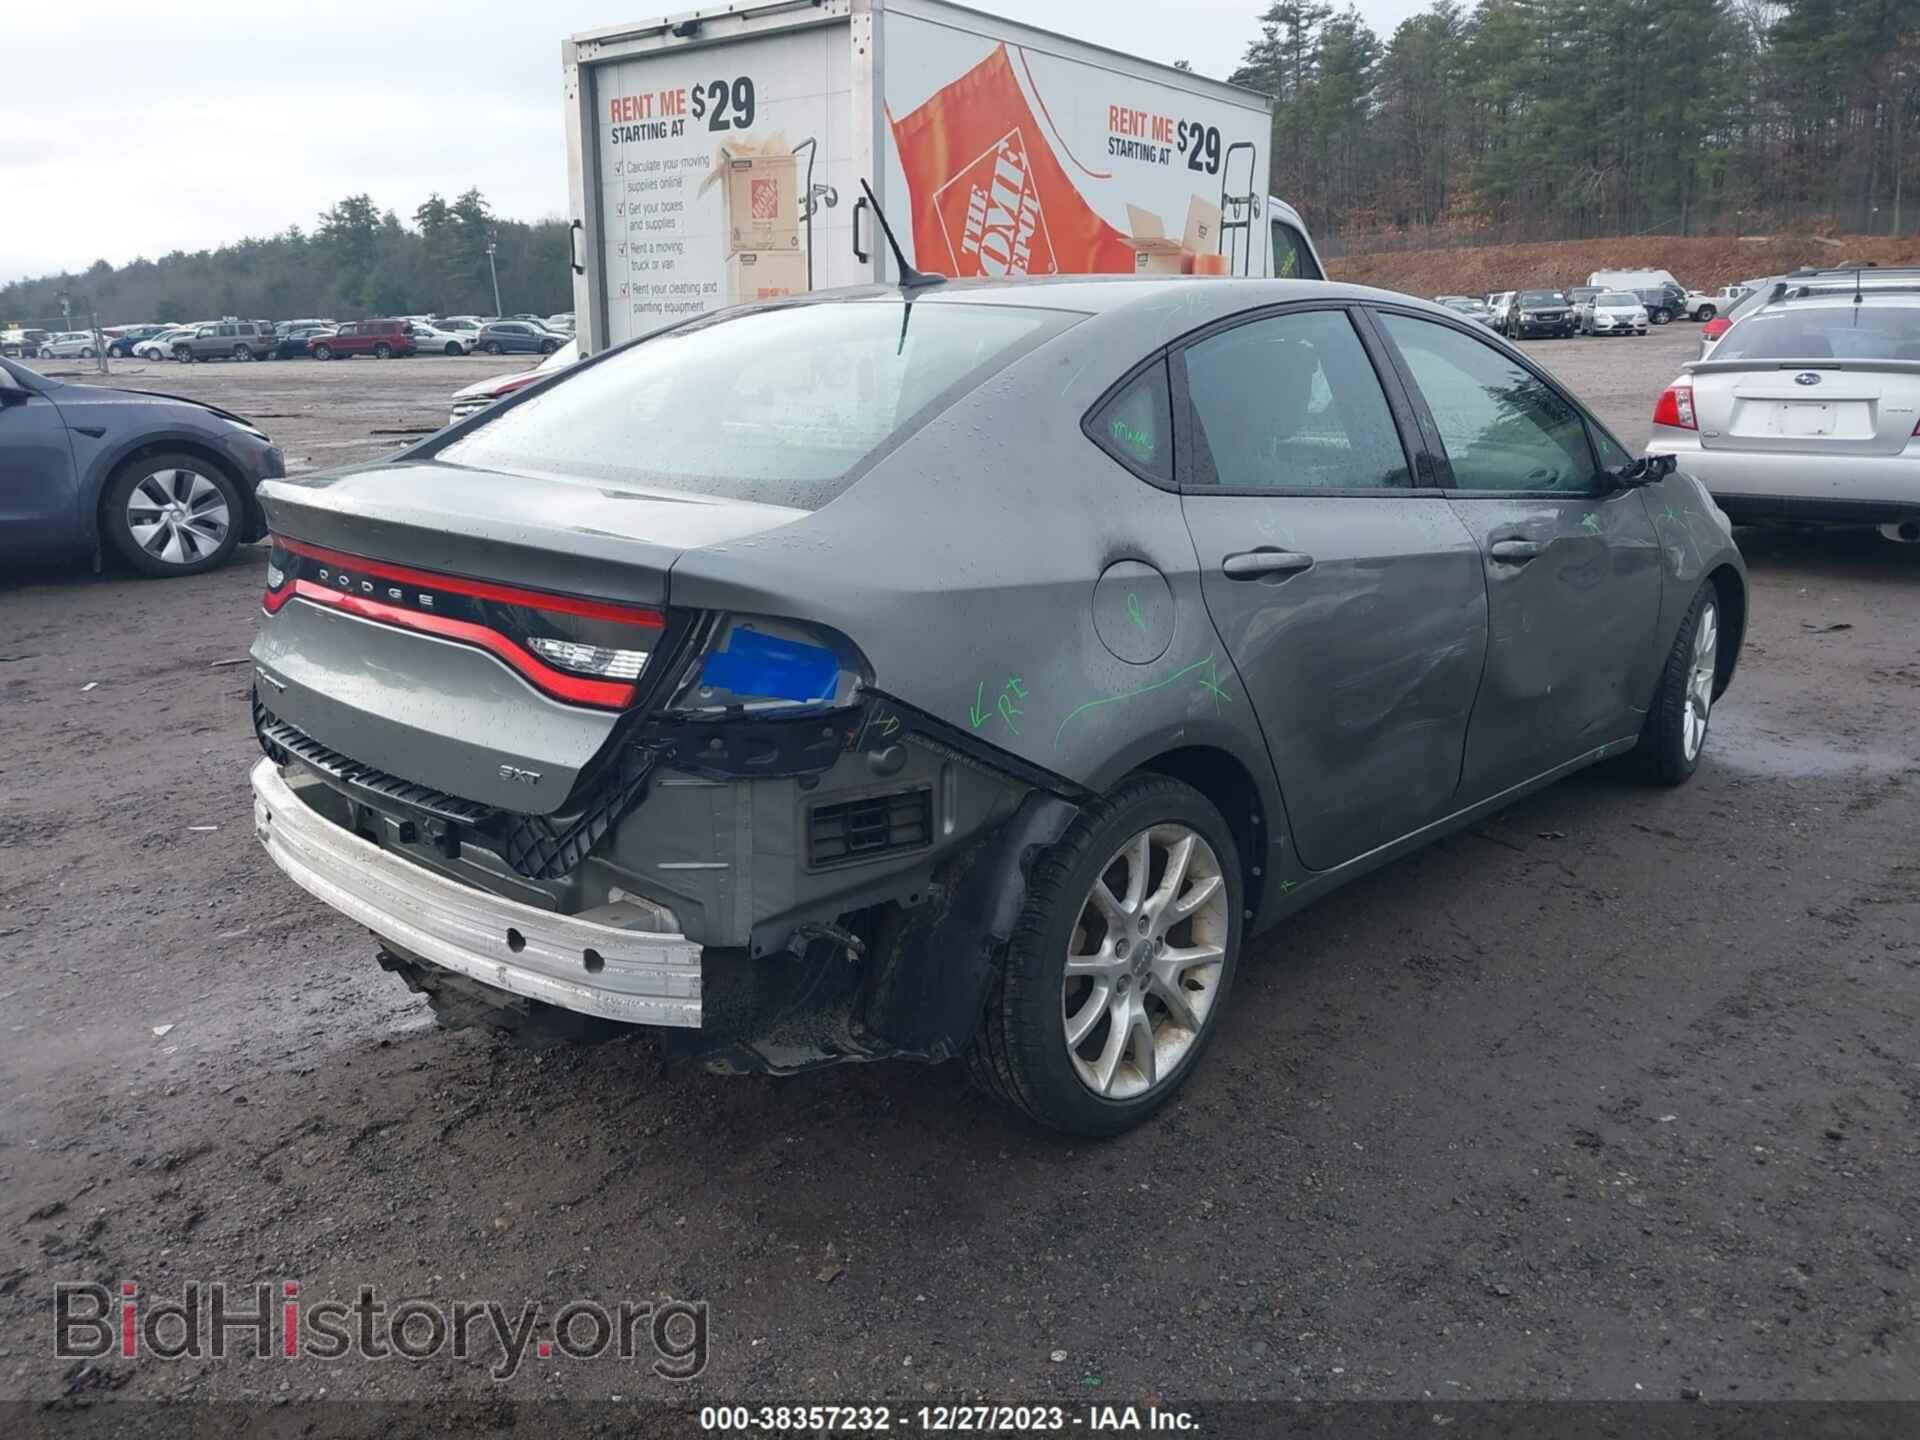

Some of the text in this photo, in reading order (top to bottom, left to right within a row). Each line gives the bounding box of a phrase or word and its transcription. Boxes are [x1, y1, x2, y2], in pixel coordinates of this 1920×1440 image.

[610, 75, 756, 132] RENT ME $29
[611, 119, 685, 145] STARTING AT
[1109, 105, 1221, 176] RENT ME $29
[1108, 136, 1171, 166] STARTING AT
[626, 154, 710, 174] Calculate your moving
[627, 176, 683, 193] supplies online
[628, 201, 684, 217] Get your boxes
[976, 138, 1027, 279] OME
[629, 218, 676, 232] and supplies
[961, 183, 989, 255] THE
[631, 242, 648, 255] Rent
[656, 241, 684, 256] moving
[631, 260, 675, 272] truck or van
[633, 281, 718, 297] Rent your cleaning and
[633, 300, 704, 315] painting equipment
[319, 568, 434, 607] DODGE
